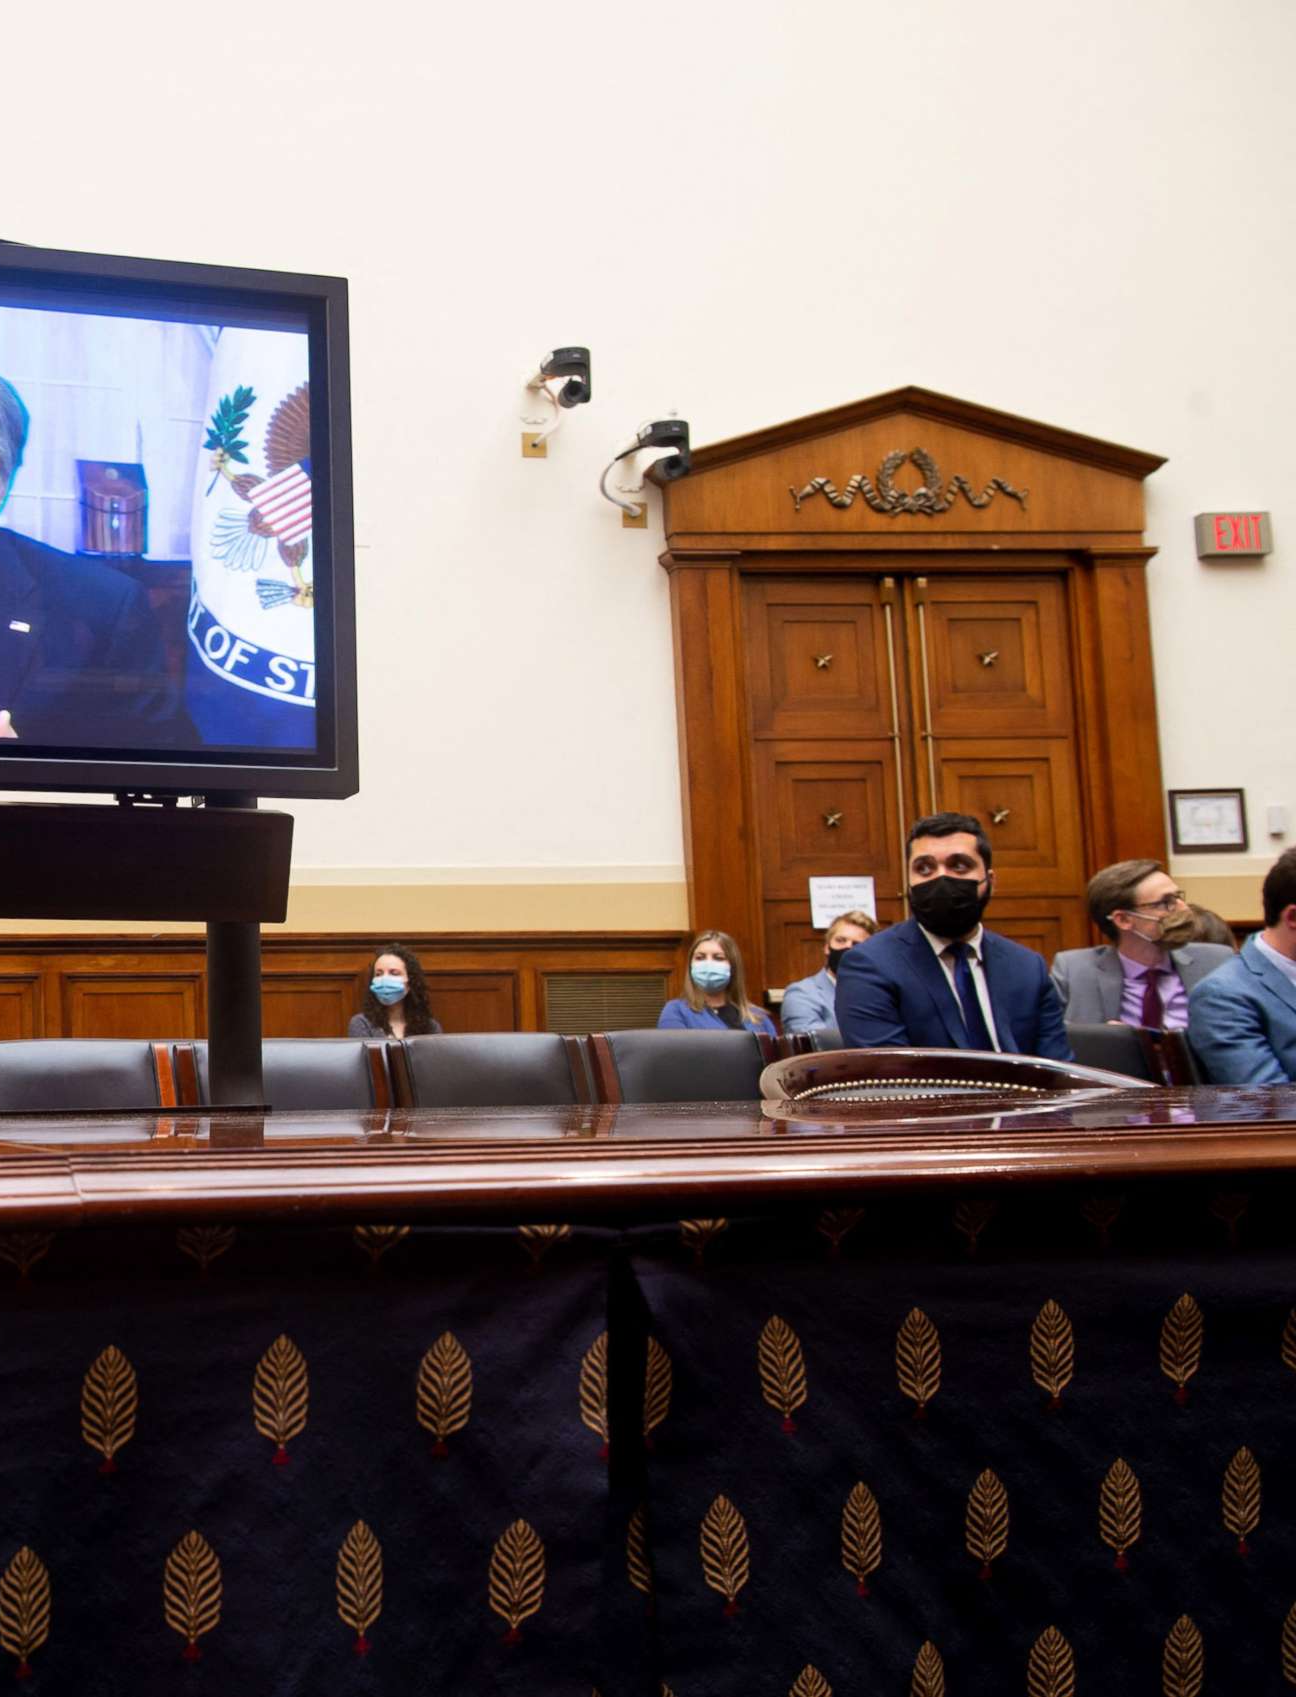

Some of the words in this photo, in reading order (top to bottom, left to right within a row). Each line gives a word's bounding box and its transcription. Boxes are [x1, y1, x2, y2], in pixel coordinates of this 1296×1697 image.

[1215, 513, 1264, 551] EXIT
[205, 624, 259, 672] OF
[264, 655, 316, 698] ST
